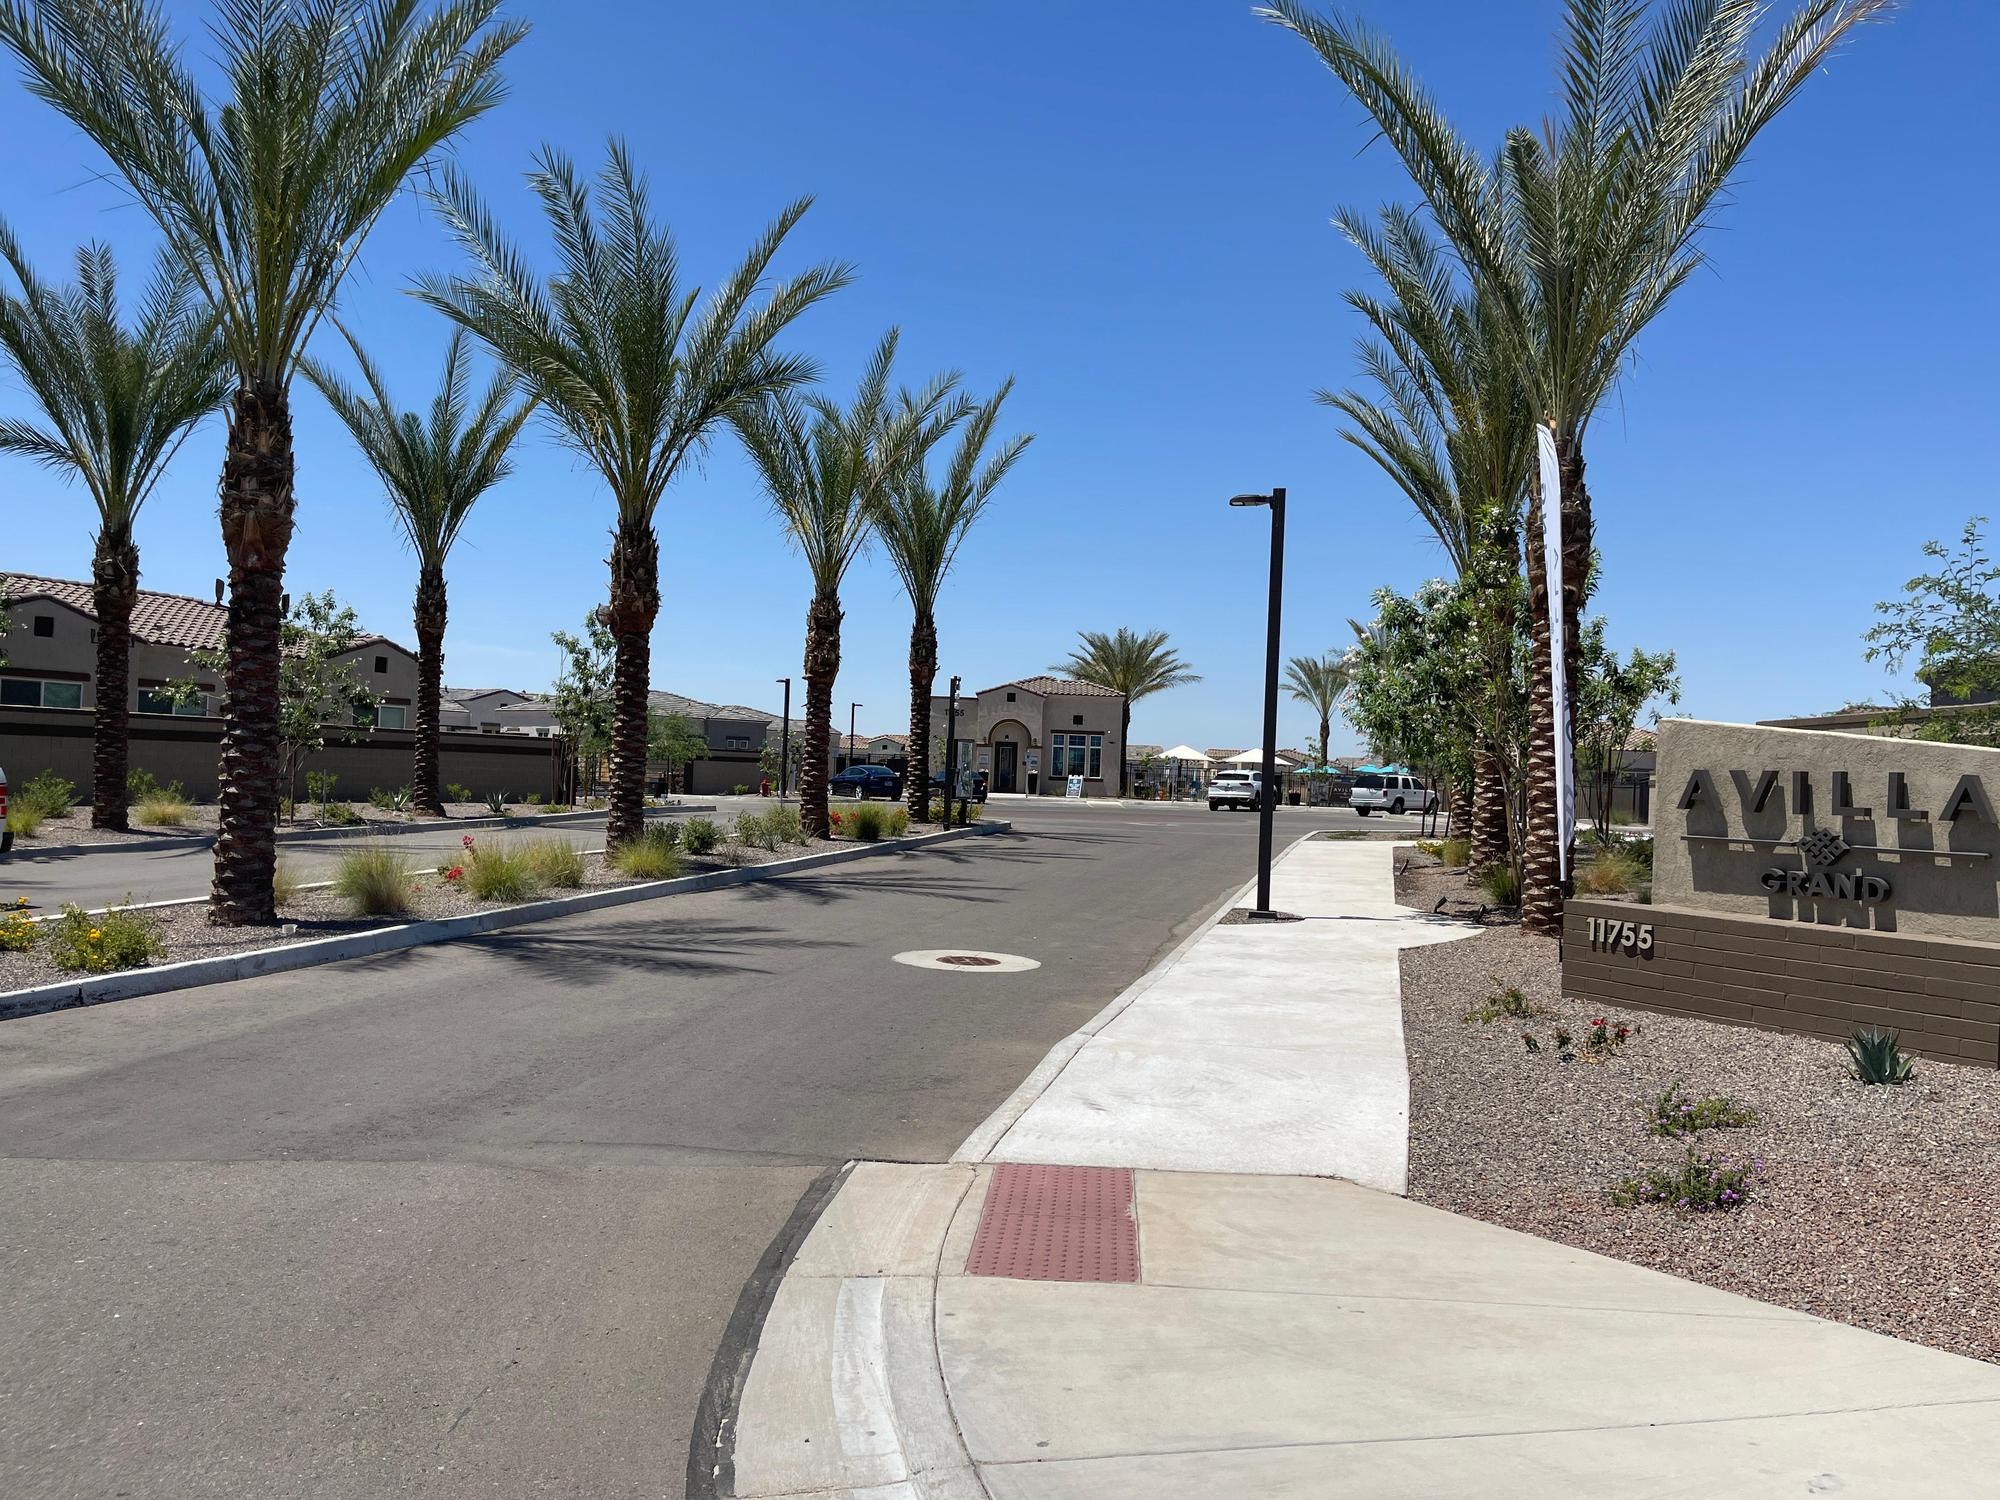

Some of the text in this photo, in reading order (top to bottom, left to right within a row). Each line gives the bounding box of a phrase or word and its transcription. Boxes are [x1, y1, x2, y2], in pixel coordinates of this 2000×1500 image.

[1676, 769, 1998, 825] AVILLA
[1760, 868, 1892, 903] GRAND
[1587, 917, 1653, 949] 11755
